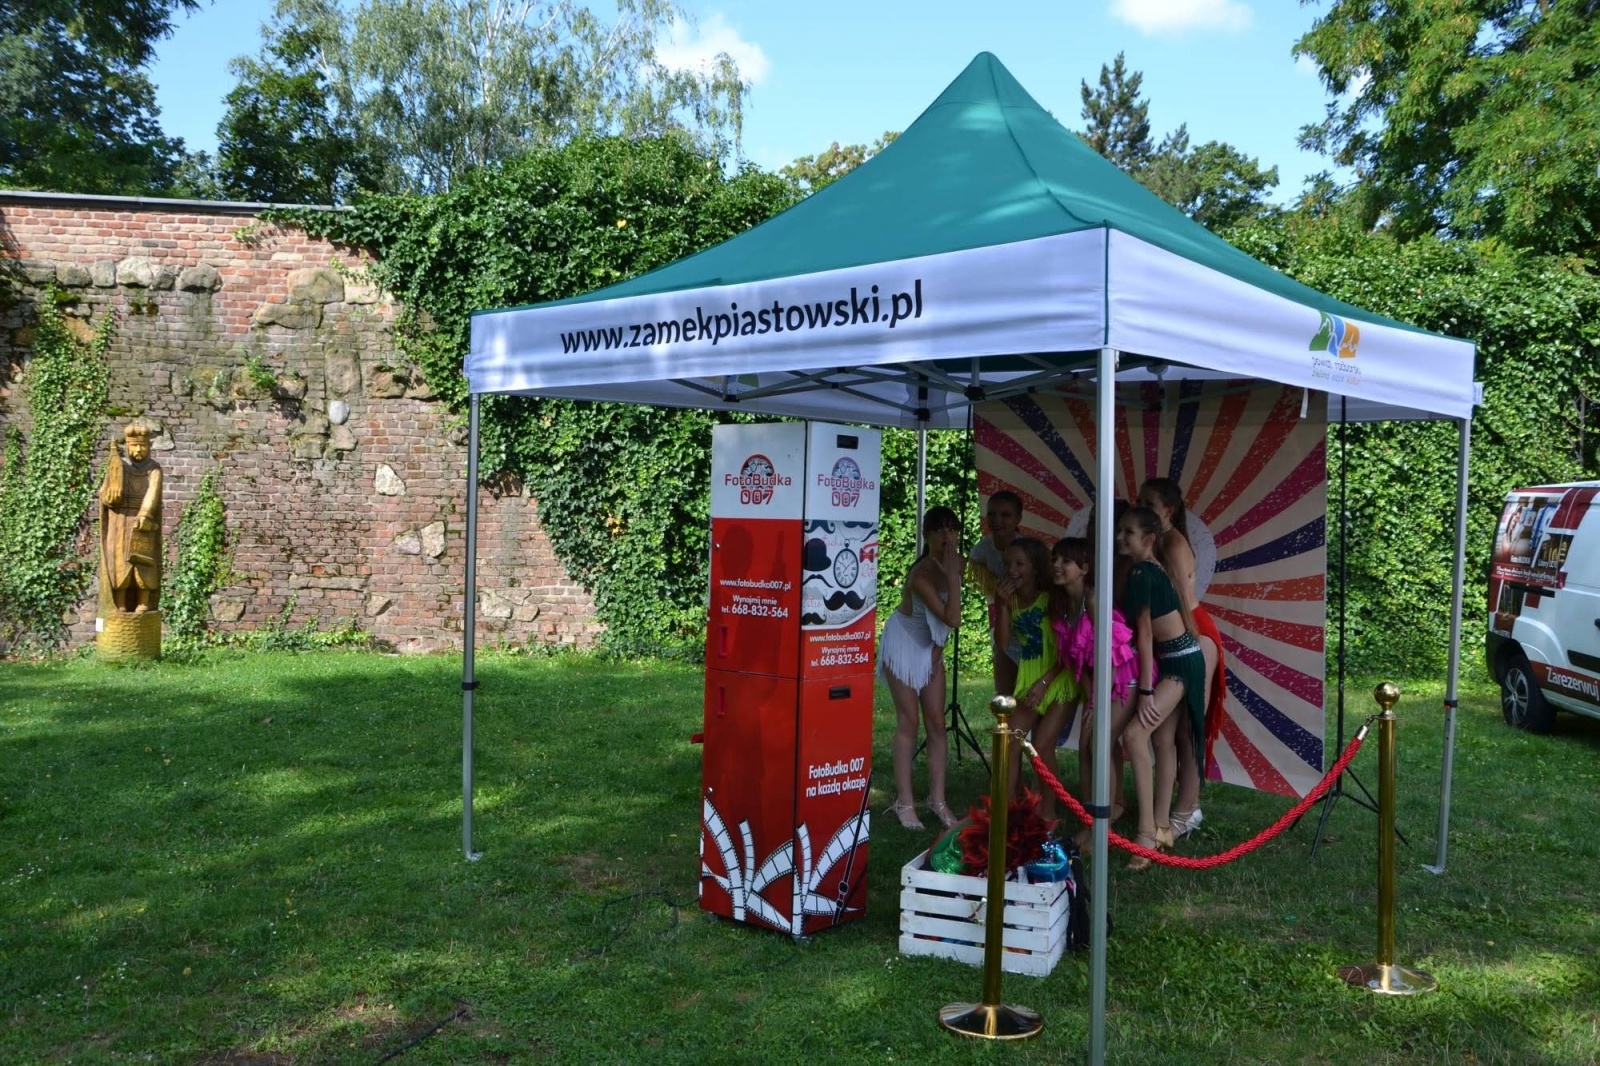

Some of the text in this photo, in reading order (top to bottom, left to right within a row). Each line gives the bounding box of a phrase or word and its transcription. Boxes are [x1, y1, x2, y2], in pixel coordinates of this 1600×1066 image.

[560, 279, 923, 354] www.zamekpiastowski.pl
[724, 474, 792, 486] FotoBudka
[817, 474, 875, 490] FotoBudka
[740, 490, 774, 505] 007
[831, 491, 860, 508] 007
[719, 578, 792, 591] www.fotobudka007.pl
[732, 595, 777, 606] Wynajmij mnie
[721, 603, 789, 618] tel. 668-832-564
[809, 631, 871, 642] www.fotobudka007.pl
[821, 644, 860, 655] Wynajmij mnie
[810, 652, 869, 667] tel. 668-832-564
[1545, 666, 1600, 702] Zarezerwuj
[808, 757, 865, 779] FotoBudka 007
[805, 774, 866, 798] na każdą okazje
